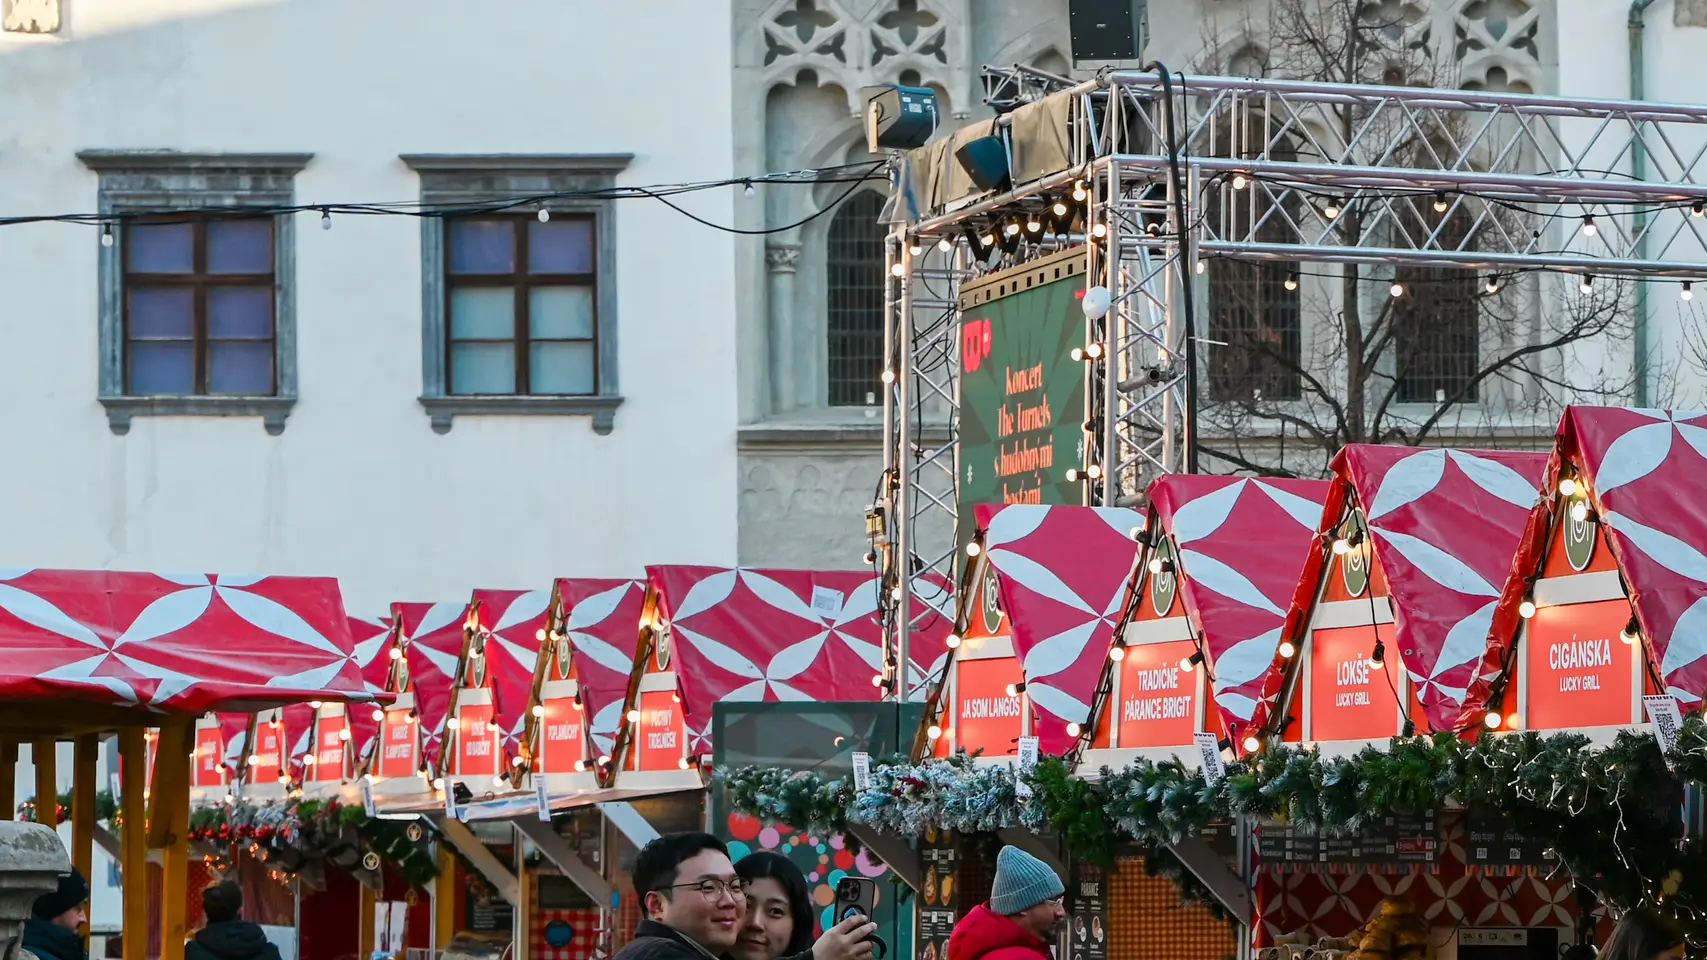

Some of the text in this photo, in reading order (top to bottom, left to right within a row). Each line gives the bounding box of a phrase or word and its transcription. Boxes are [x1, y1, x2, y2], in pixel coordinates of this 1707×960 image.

[997, 404, 1013, 437] The
[1001, 434, 1053, 477] hudobnými
[1550, 634, 1611, 669] CIGÁNSKA
[1138, 661, 1178, 690] TRADIČNÉ
[1338, 654, 1370, 685] LOKŠE
[1560, 675, 1600, 692] LUCKY GRILL
[962, 704, 971, 719] JA
[972, 702, 988, 718] SOM
[1125, 695, 1191, 721] PÁRANCE BRIGIT
[1336, 692, 1370, 706] LUCKY GRILL
